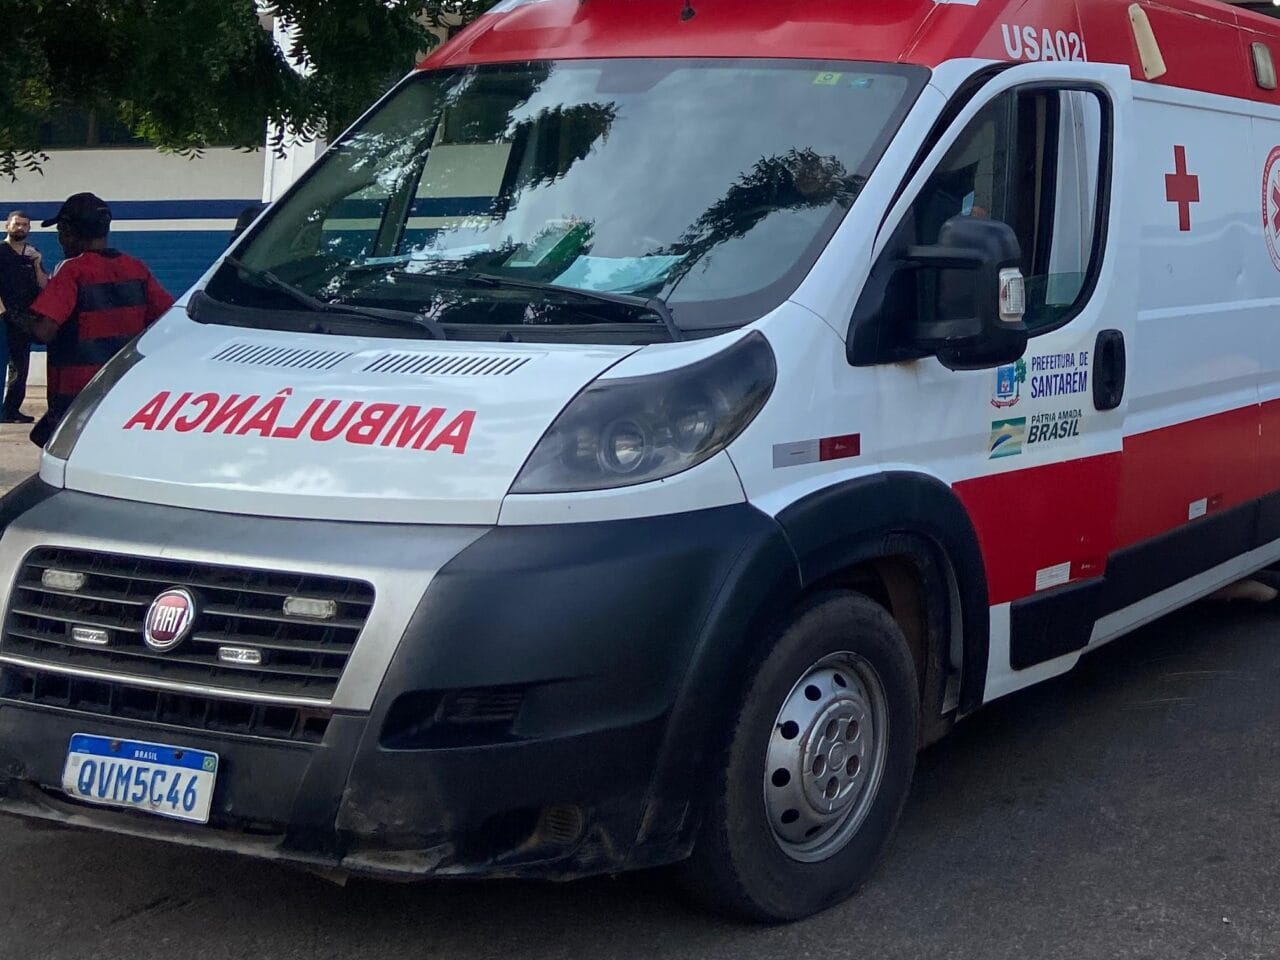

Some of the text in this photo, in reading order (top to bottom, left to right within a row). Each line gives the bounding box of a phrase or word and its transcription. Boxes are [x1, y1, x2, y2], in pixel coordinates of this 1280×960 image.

[1001, 23, 1083, 62] USA02
[1031, 351, 1089, 371] PREFEITURA DE
[1031, 367, 1088, 399] SANTARÉM
[1058, 409, 1082, 420] AMADA
[1027, 419, 1080, 444] BRASIL
[153, 605, 184, 633] FIAT
[134, 750, 158, 761] BRASIL
[77, 759, 198, 812] QVM5C46
